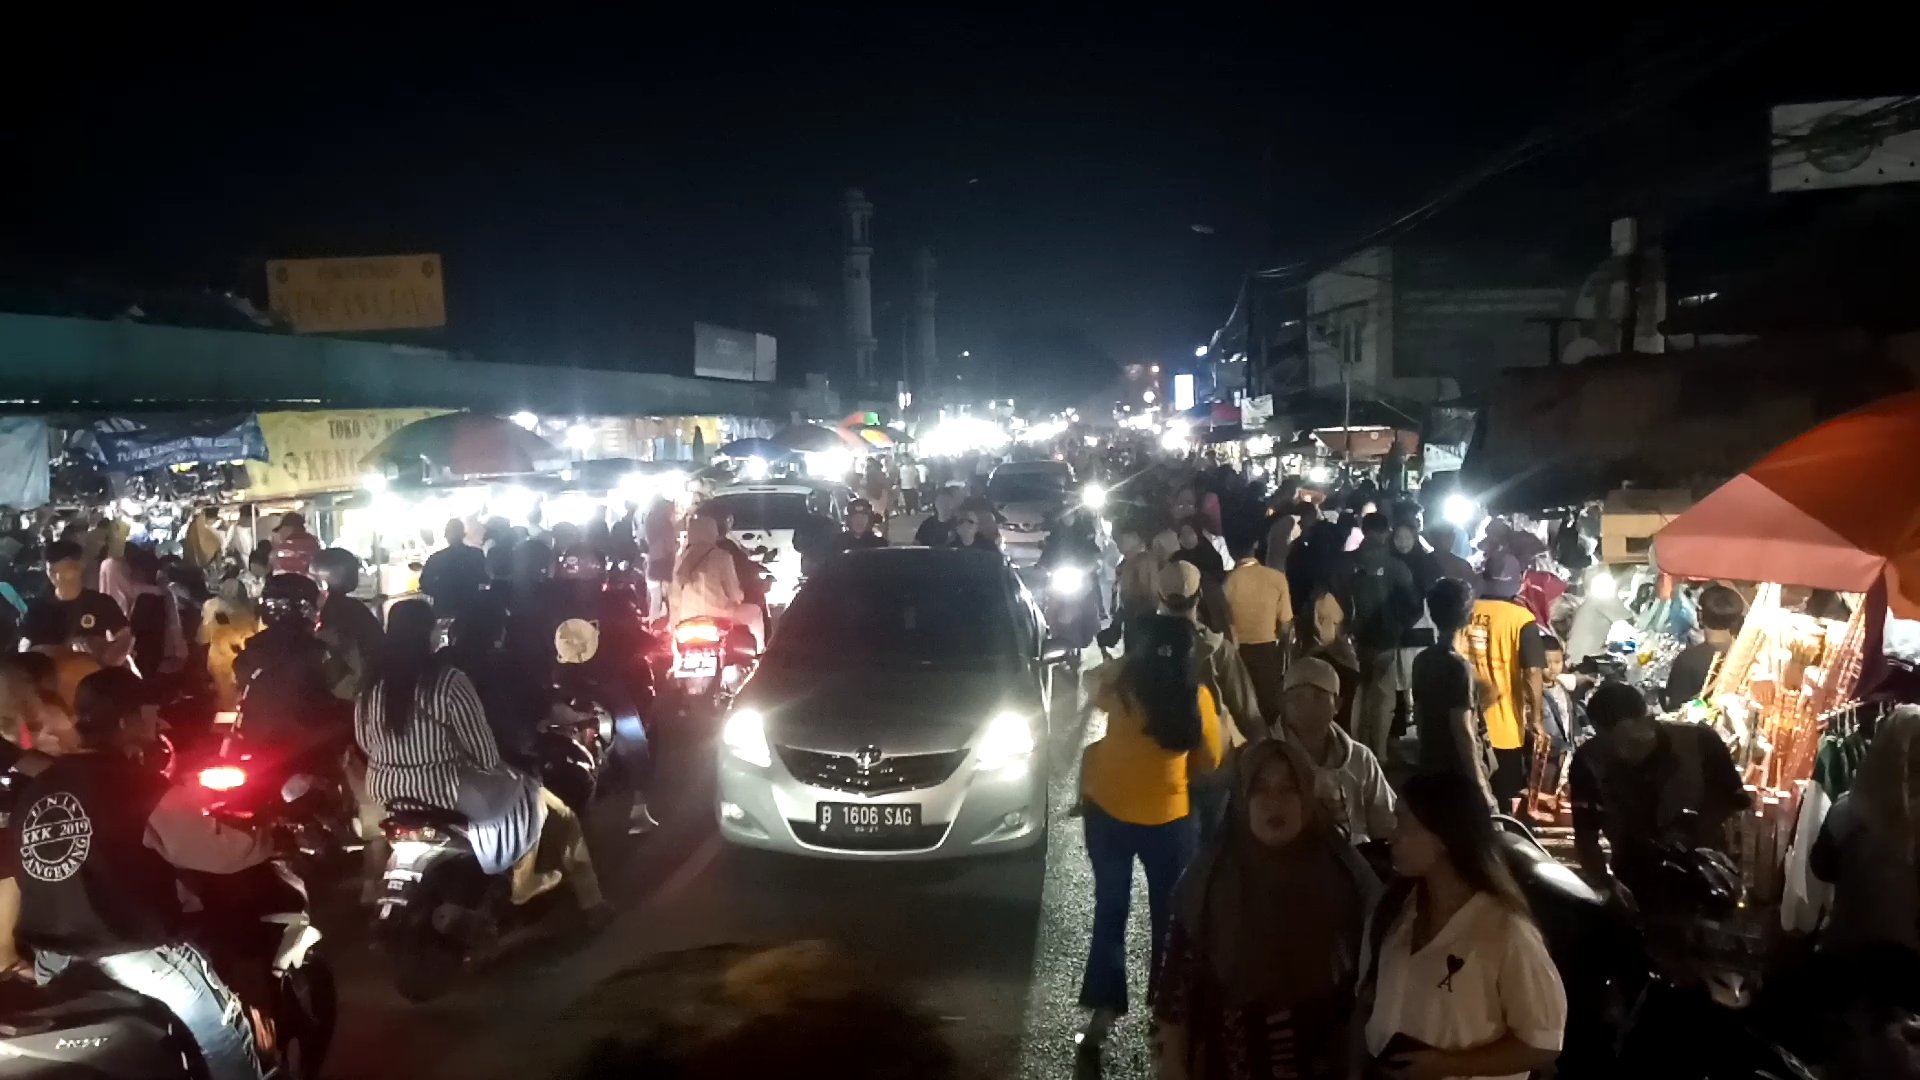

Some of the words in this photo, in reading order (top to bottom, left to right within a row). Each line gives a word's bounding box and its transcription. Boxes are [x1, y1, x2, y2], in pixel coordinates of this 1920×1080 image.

[328, 419, 361, 440] TOKO
[822, 805, 832, 824] B
[843, 806, 879, 825] 1606
[884, 807, 912, 826] SAG
[60, 821, 89, 837] 2019
